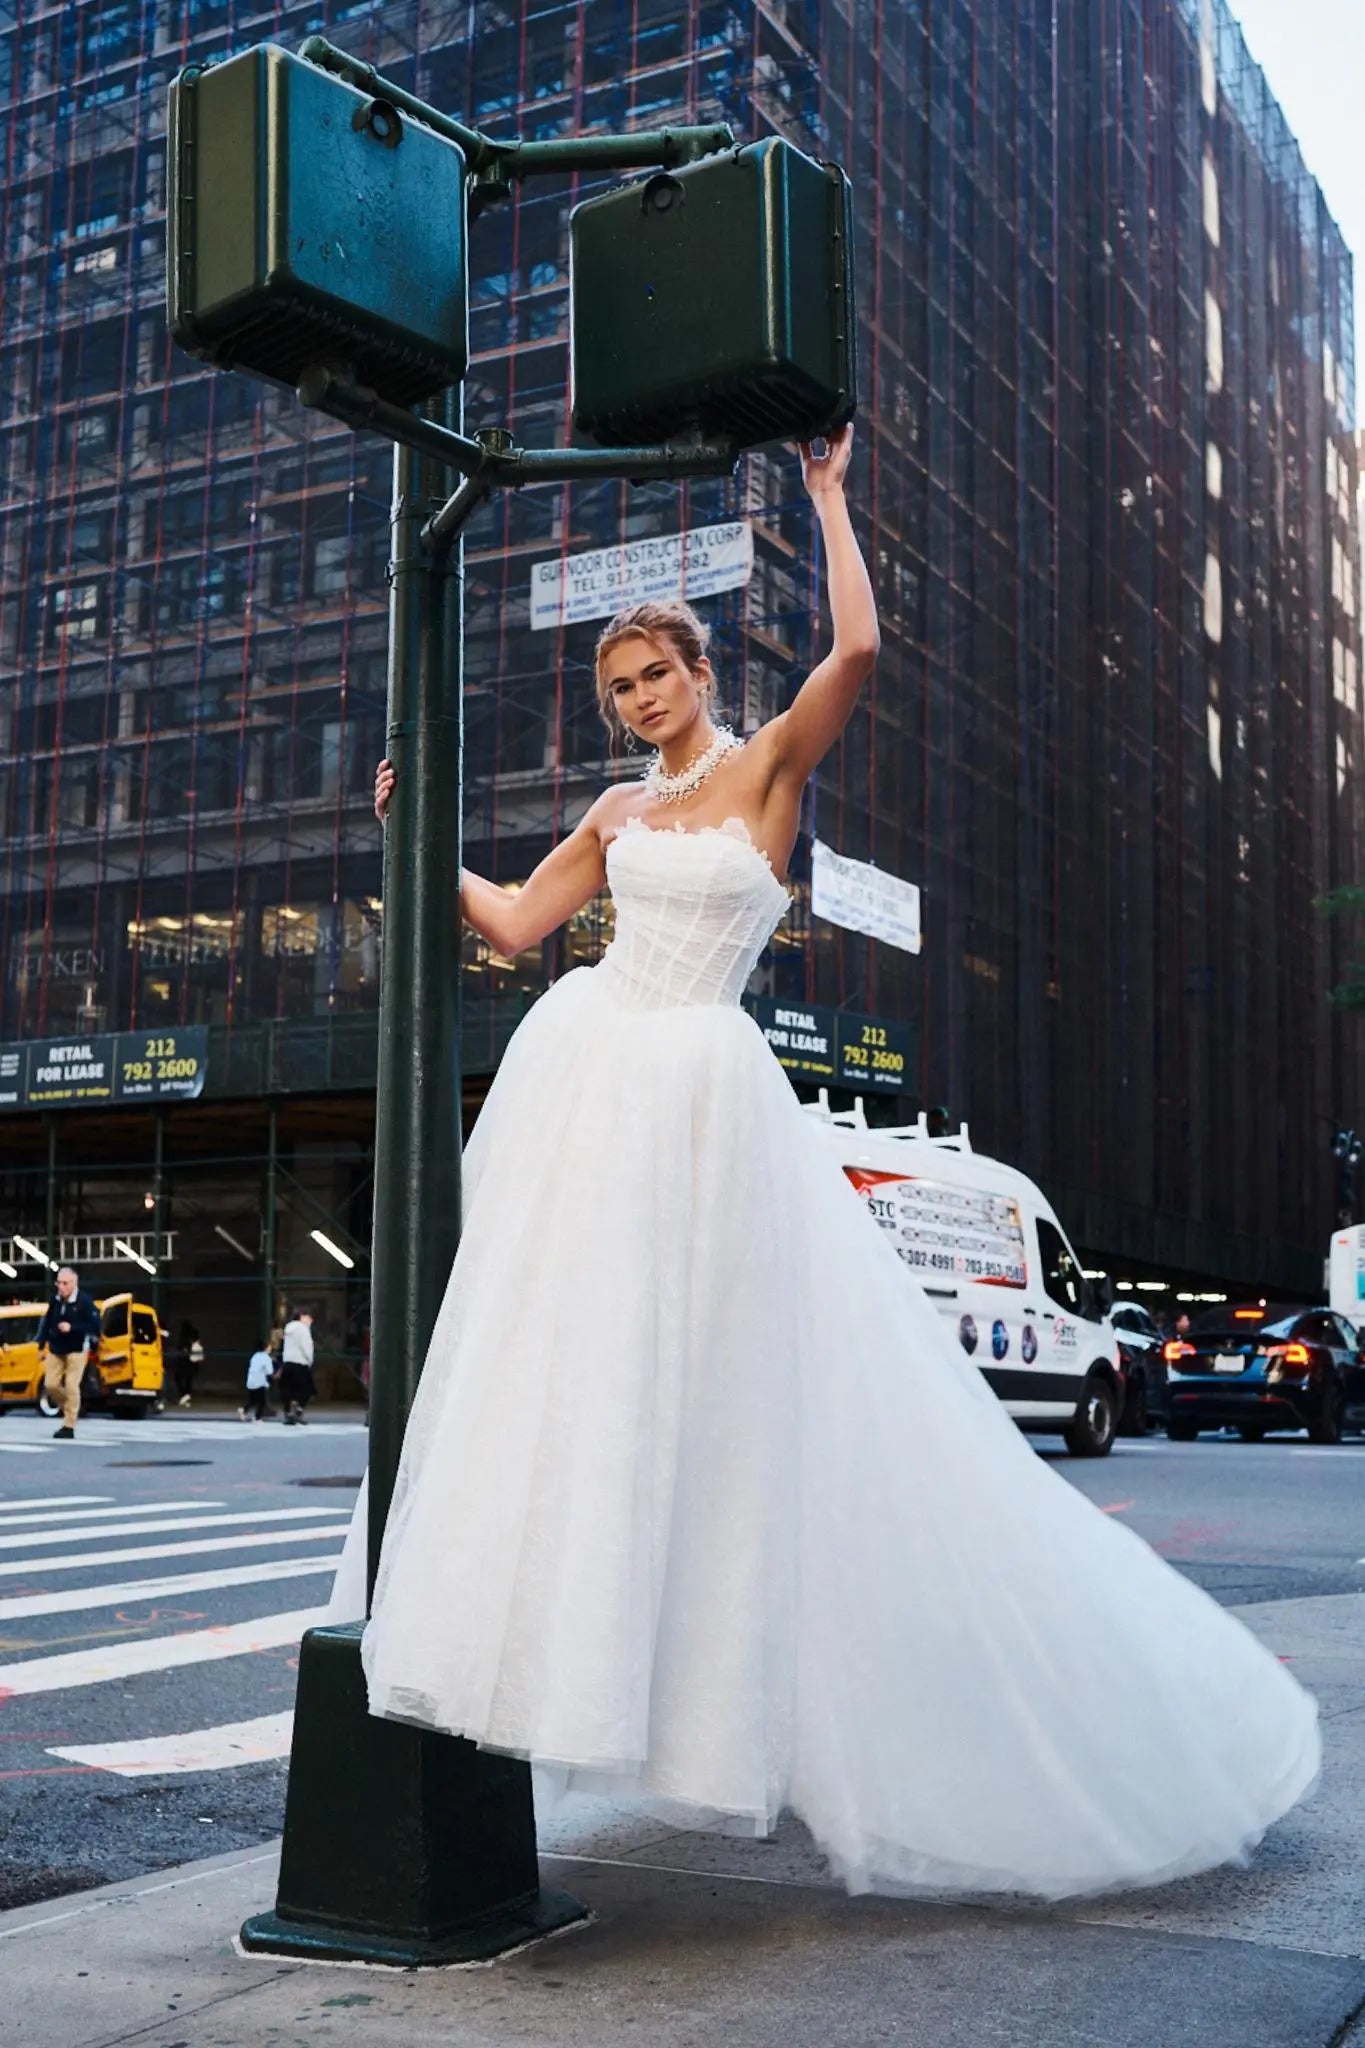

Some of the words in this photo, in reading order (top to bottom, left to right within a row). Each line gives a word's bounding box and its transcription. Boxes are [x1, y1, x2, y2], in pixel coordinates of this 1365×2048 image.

[606, 532, 704, 569] CONSTRUCTON
[775, 1009, 817, 1031] RETAIL
[764, 1028, 788, 1047] FOR
[790, 1032, 828, 1054] LEASE
[861, 1025, 888, 1046] 212
[49, 1045, 94, 1063] RETAIL
[145, 1038, 176, 1058] 212
[843, 1045, 868, 1065] 792
[872, 1050, 904, 1071] 2600
[36, 1067, 62, 1083] FOR
[64, 1063, 105, 1081] LEASE
[123, 1062, 152, 1081] 792
[156, 1058, 198, 1078] 2600
[867, 1198, 896, 1219] STC
